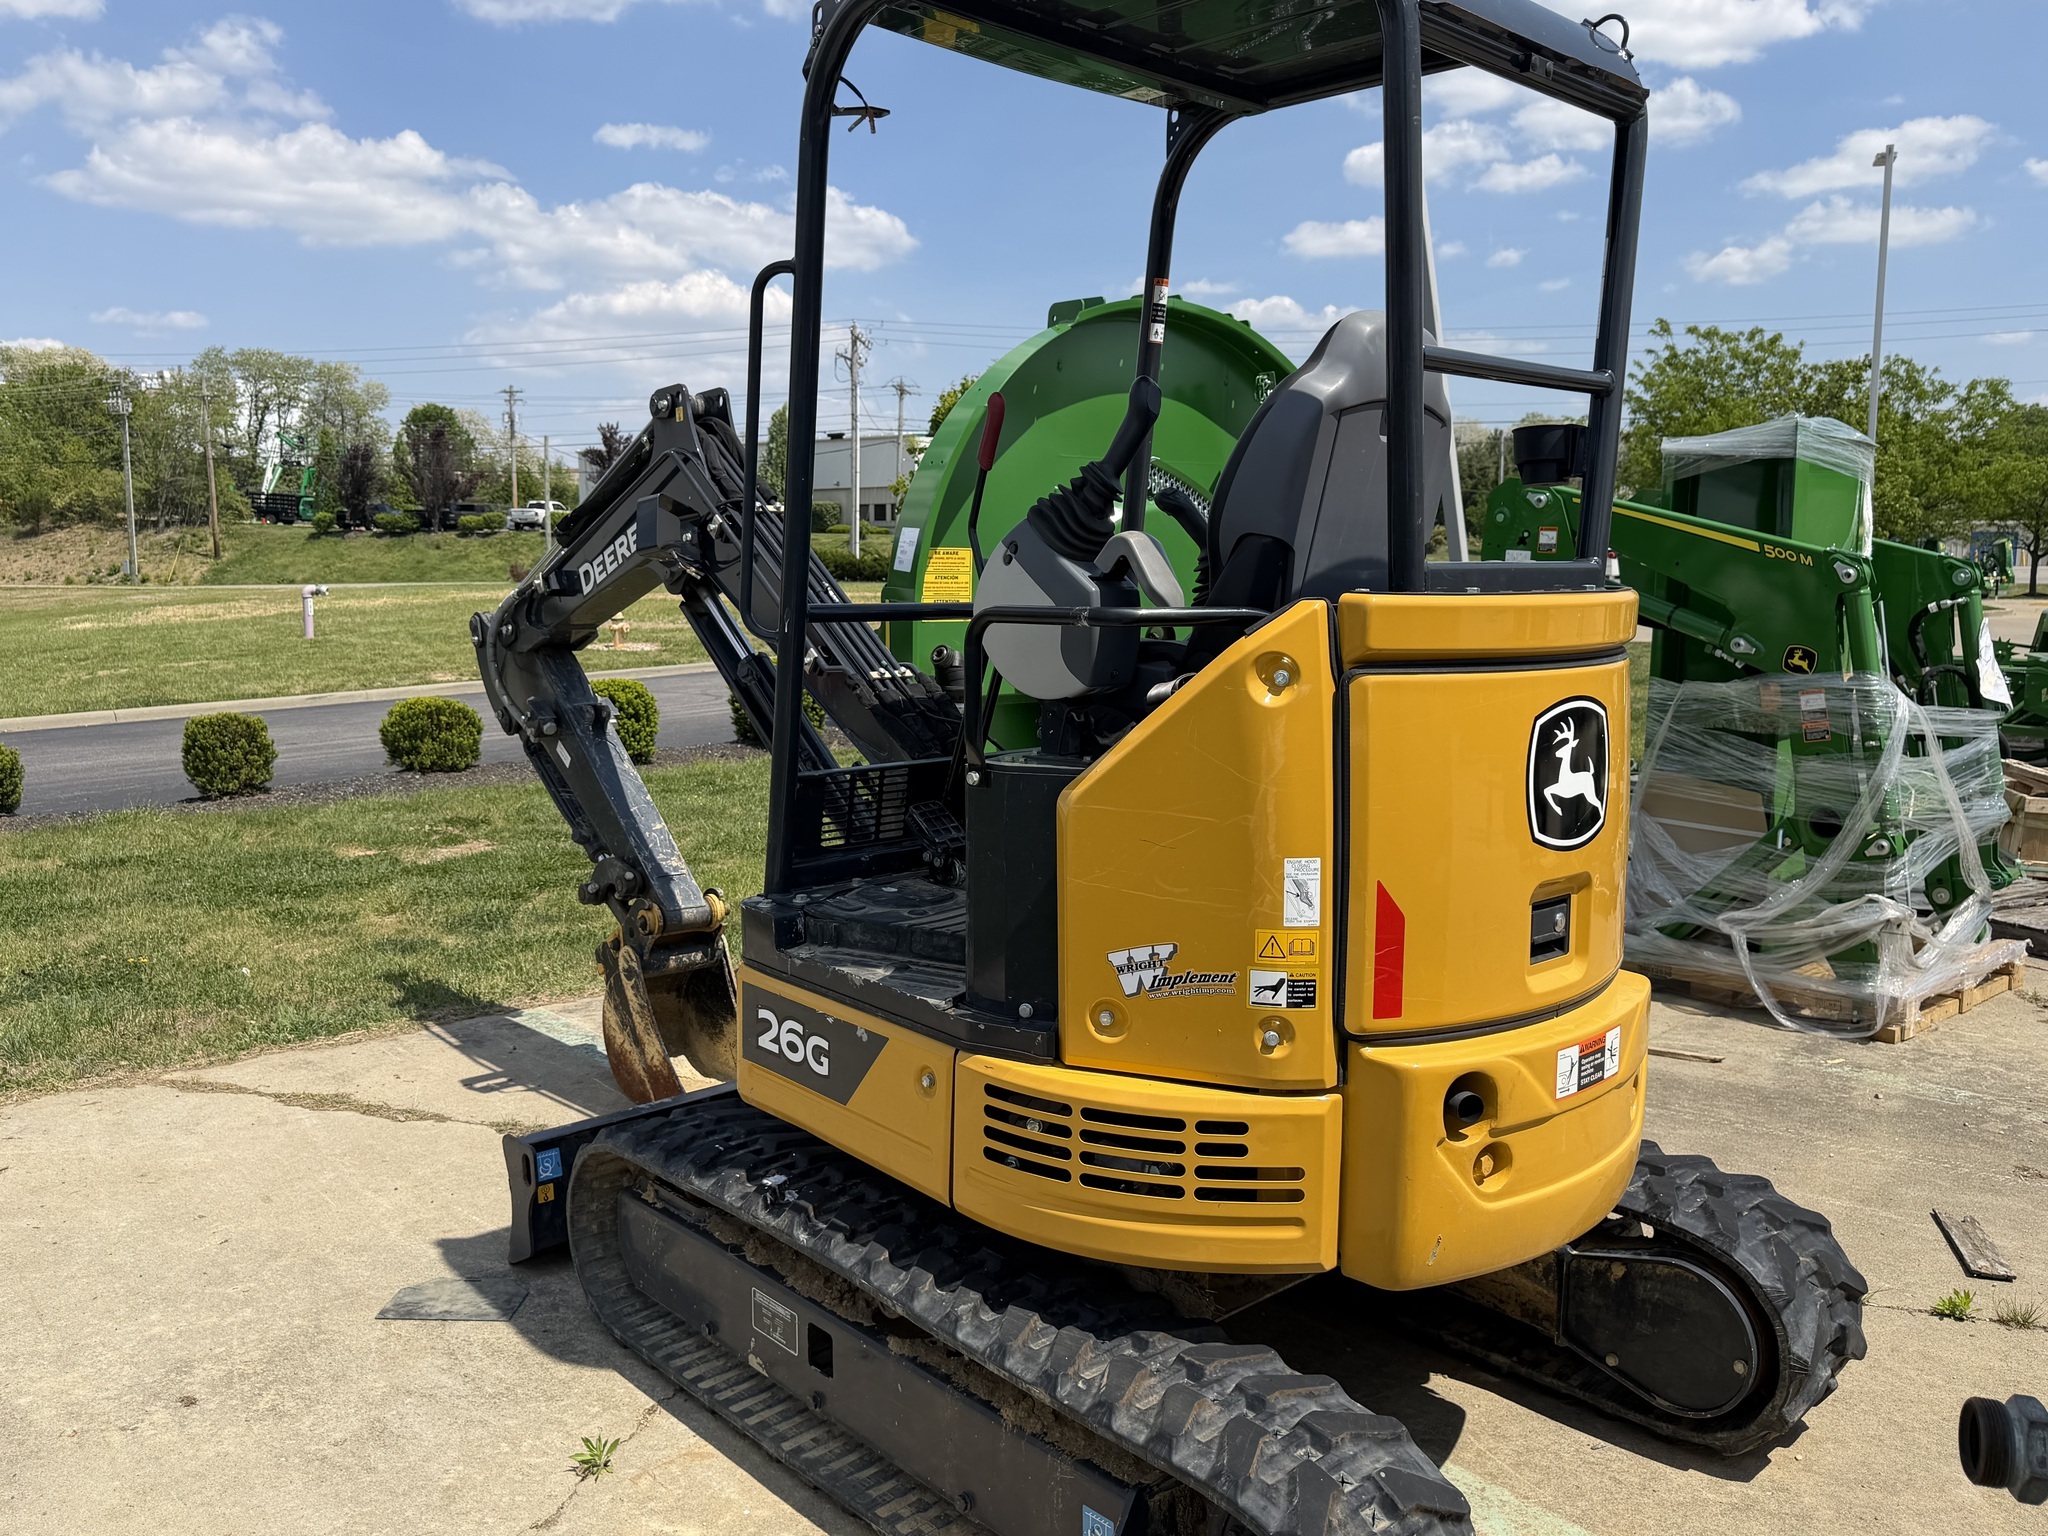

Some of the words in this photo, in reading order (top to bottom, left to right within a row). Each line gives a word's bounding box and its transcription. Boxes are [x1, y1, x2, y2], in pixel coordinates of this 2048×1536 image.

[579, 522, 637, 596] DEERE
[1764, 544, 1797, 562] 500
[1800, 553, 1813, 566] M
[1116, 960, 1166, 974] WRIGHT
[1149, 971, 1237, 990] Implement
[1148, 988, 1236, 999] www.wrightimp.com
[758, 1008, 829, 1076] 26G
[1584, 1035, 1606, 1050] WARNING
[1580, 1077, 1590, 1085] STAY
[1591, 1071, 1602, 1081] CLEAR
